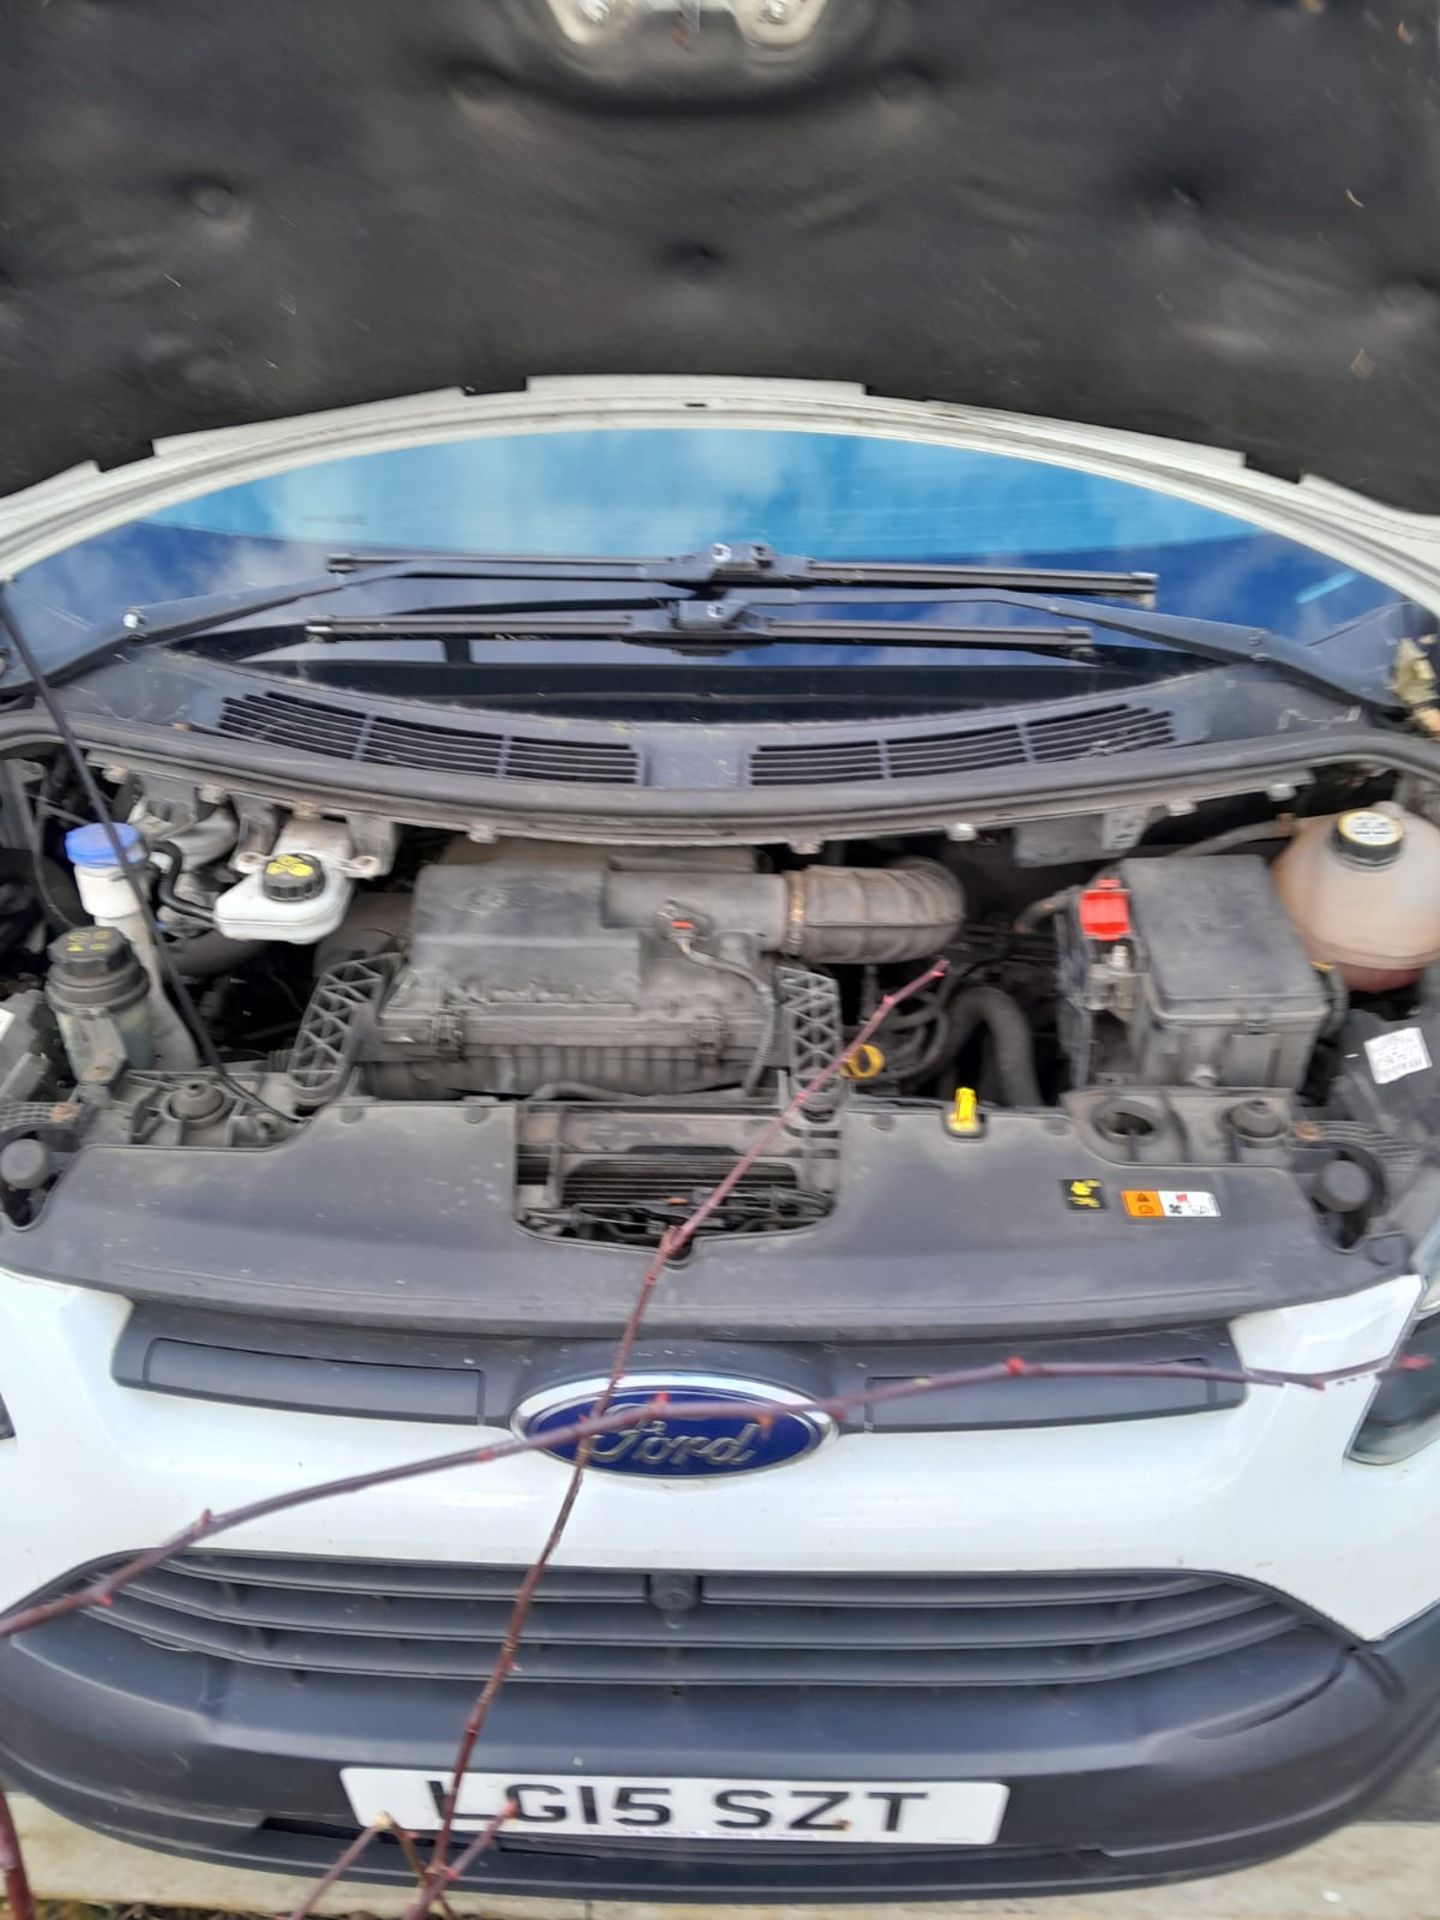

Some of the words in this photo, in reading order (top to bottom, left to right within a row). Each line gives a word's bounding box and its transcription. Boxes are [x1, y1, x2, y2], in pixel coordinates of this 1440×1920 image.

[585, 1401, 760, 1466] Ford
[426, 1779, 672, 1827] LG15
[711, 1788, 929, 1832] SZT
